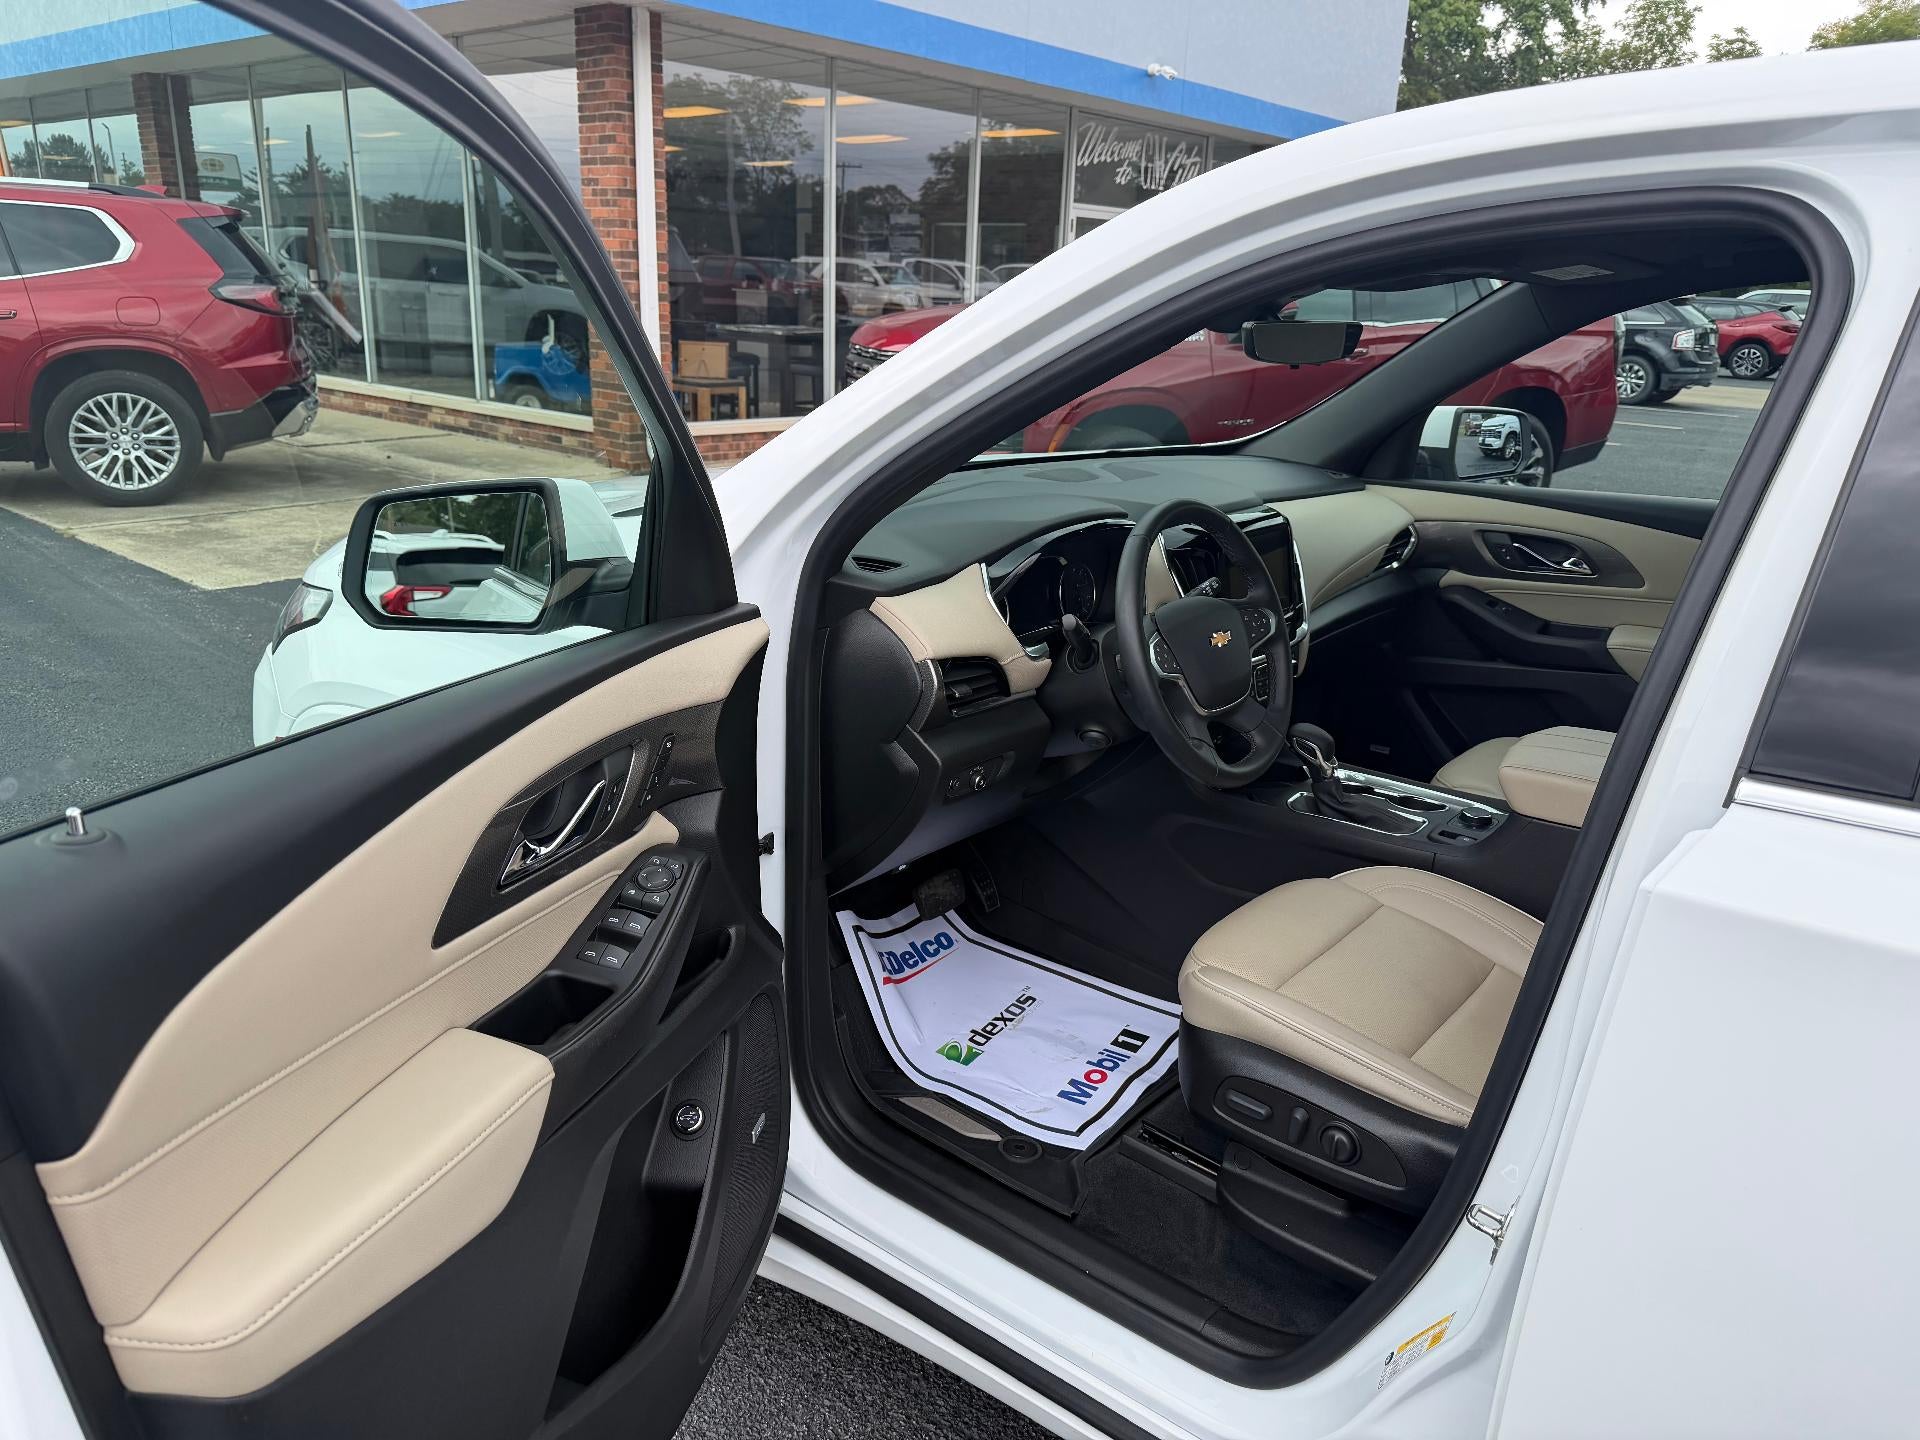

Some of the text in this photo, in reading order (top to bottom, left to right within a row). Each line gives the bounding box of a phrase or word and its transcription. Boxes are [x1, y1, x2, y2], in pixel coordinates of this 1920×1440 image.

[1077, 122, 1141, 166] Welcome
[1114, 161, 1132, 185] to
[1056, 1048, 1132, 1106] Mobil
